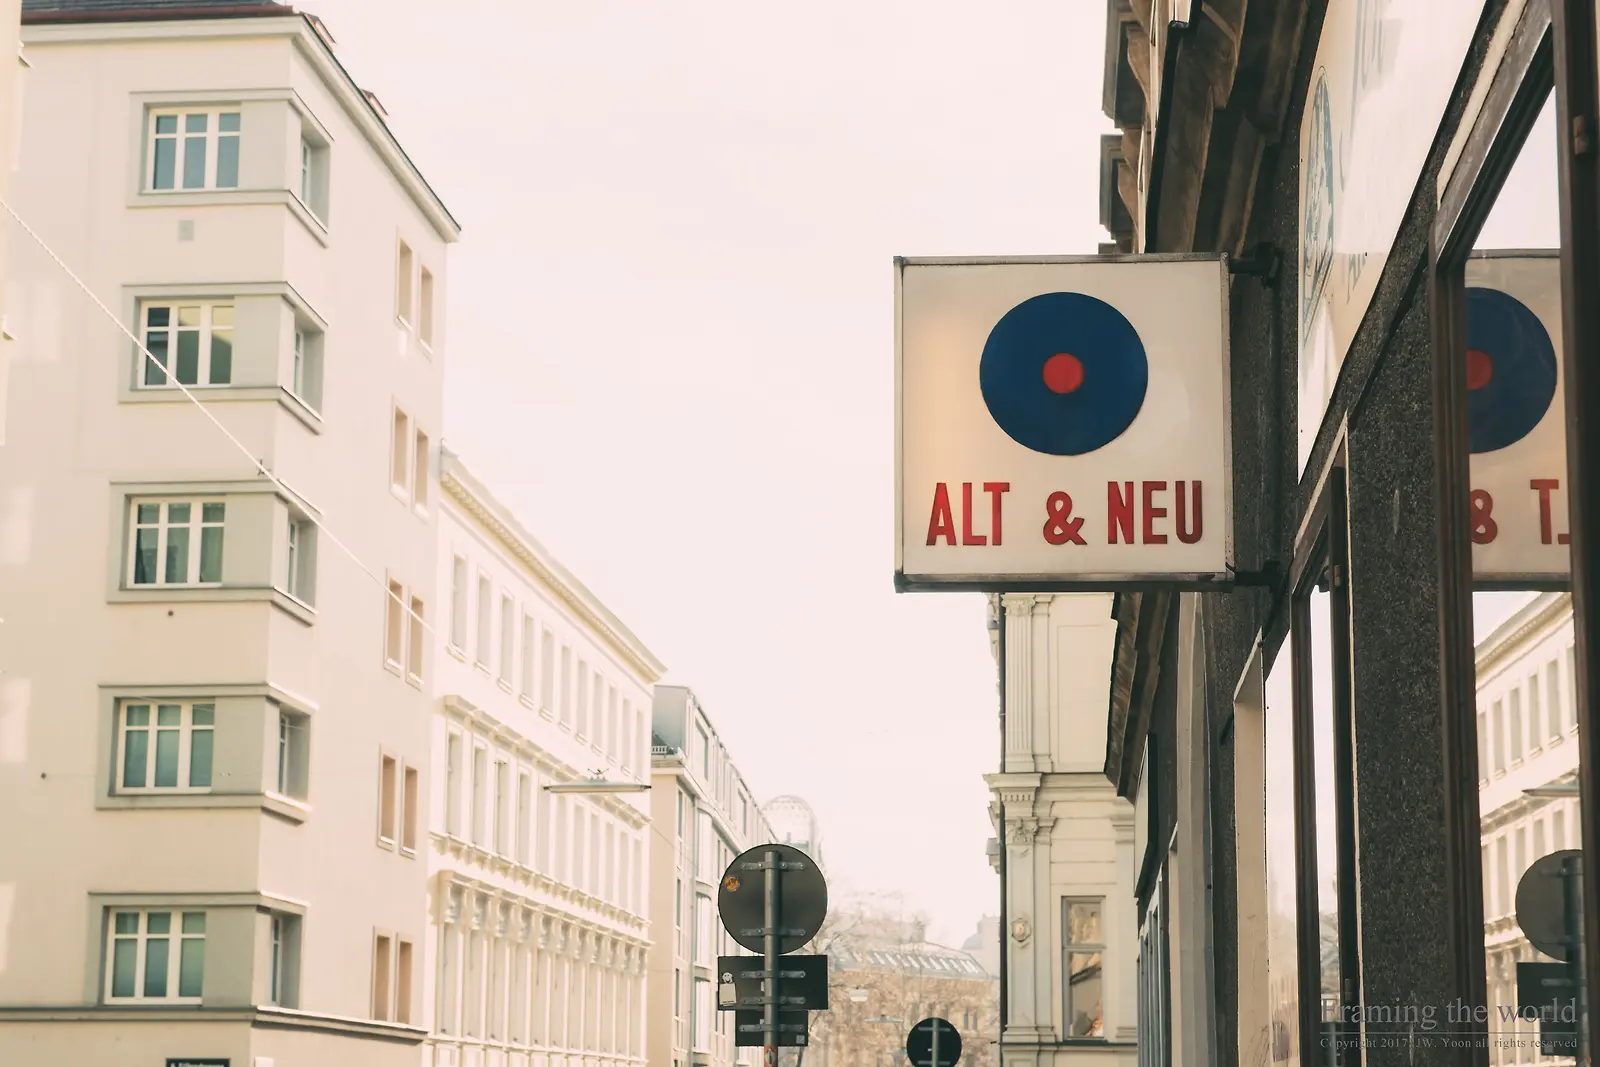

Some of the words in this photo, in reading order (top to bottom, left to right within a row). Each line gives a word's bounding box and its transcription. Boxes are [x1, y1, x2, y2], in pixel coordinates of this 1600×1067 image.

[926, 482, 1010, 546] ALT
[1043, 490, 1088, 545] &
[1107, 480, 1203, 545] NEU
